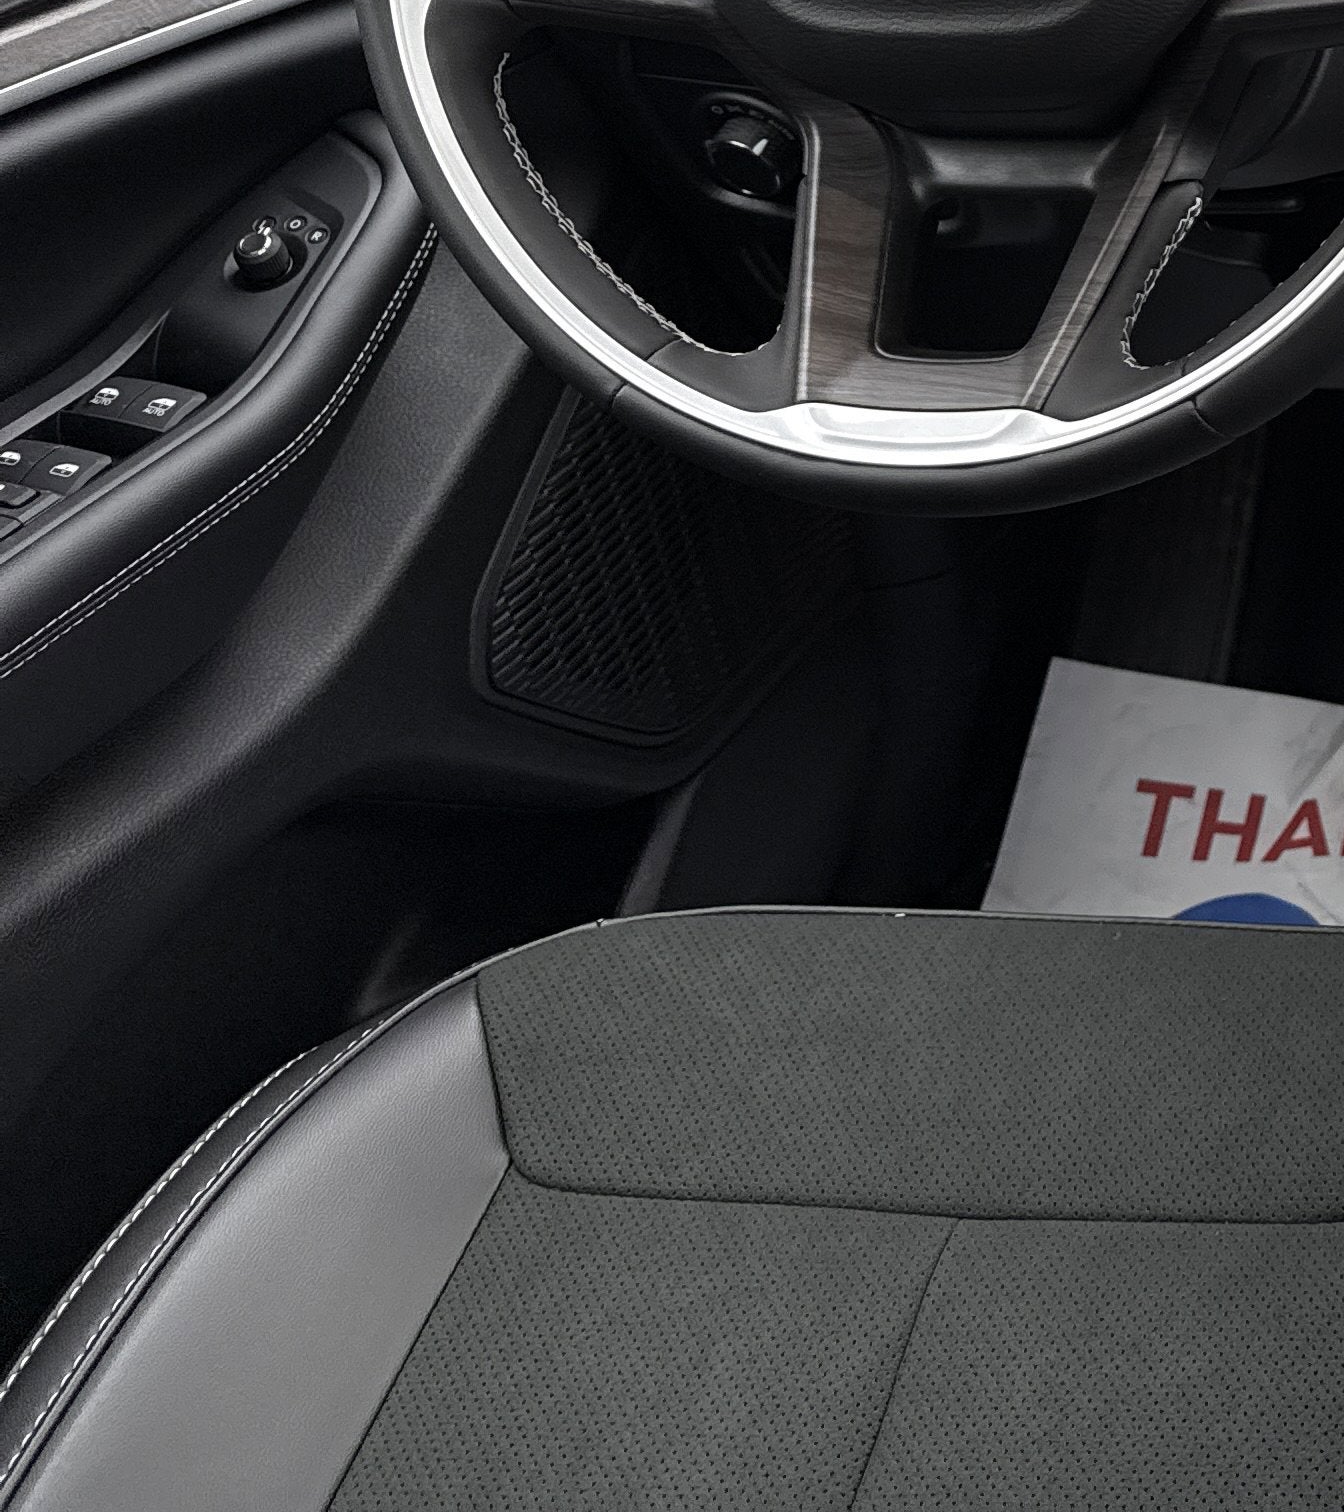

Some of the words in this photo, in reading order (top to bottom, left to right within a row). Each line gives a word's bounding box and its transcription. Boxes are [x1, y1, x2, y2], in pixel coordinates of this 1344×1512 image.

[310, 231, 323, 241] R
[89, 397, 112, 406] AUTO
[142, 407, 165, 417] AUTO
